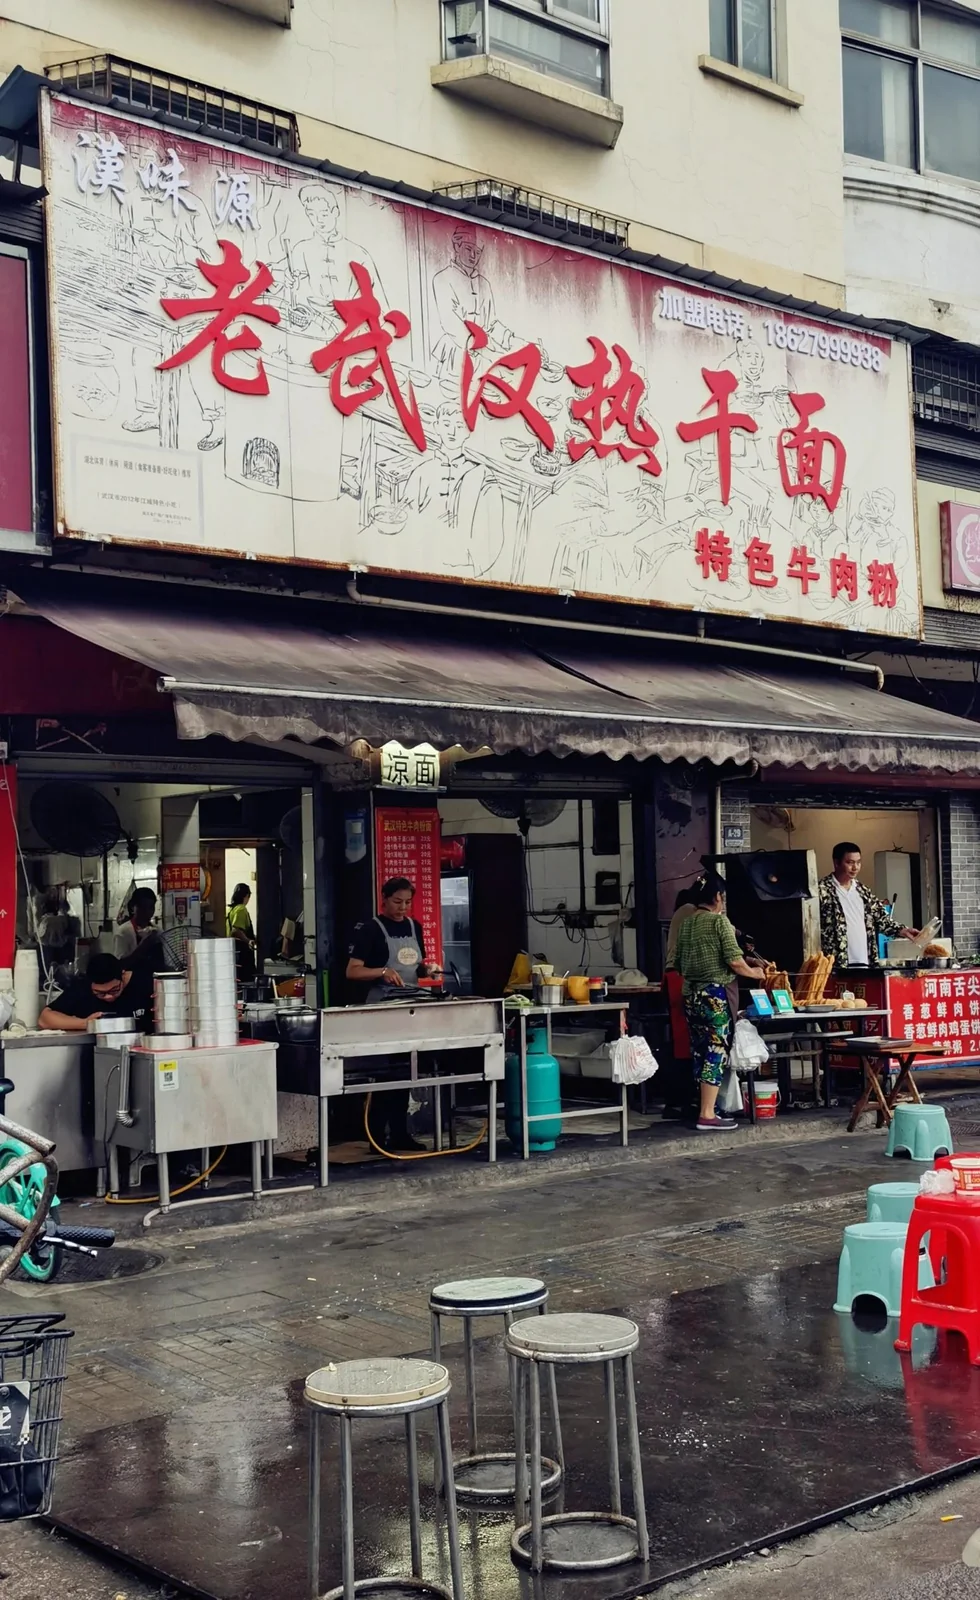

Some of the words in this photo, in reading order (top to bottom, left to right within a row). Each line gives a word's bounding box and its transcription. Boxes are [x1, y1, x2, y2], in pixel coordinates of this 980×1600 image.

[72, 131, 260, 232] 漢味源
[763, 319, 883, 372] 18627999938
[155, 239, 847, 512] 老武汉热干面
[695, 528, 900, 609] 特色牛肉粉
[388, 750, 436, 786] 凉面
[163, 867, 200, 880] 热干面区
[924, 975, 980, 999] 河南舌尖
[903, 1000, 980, 1021] 香葱鲜肉饼
